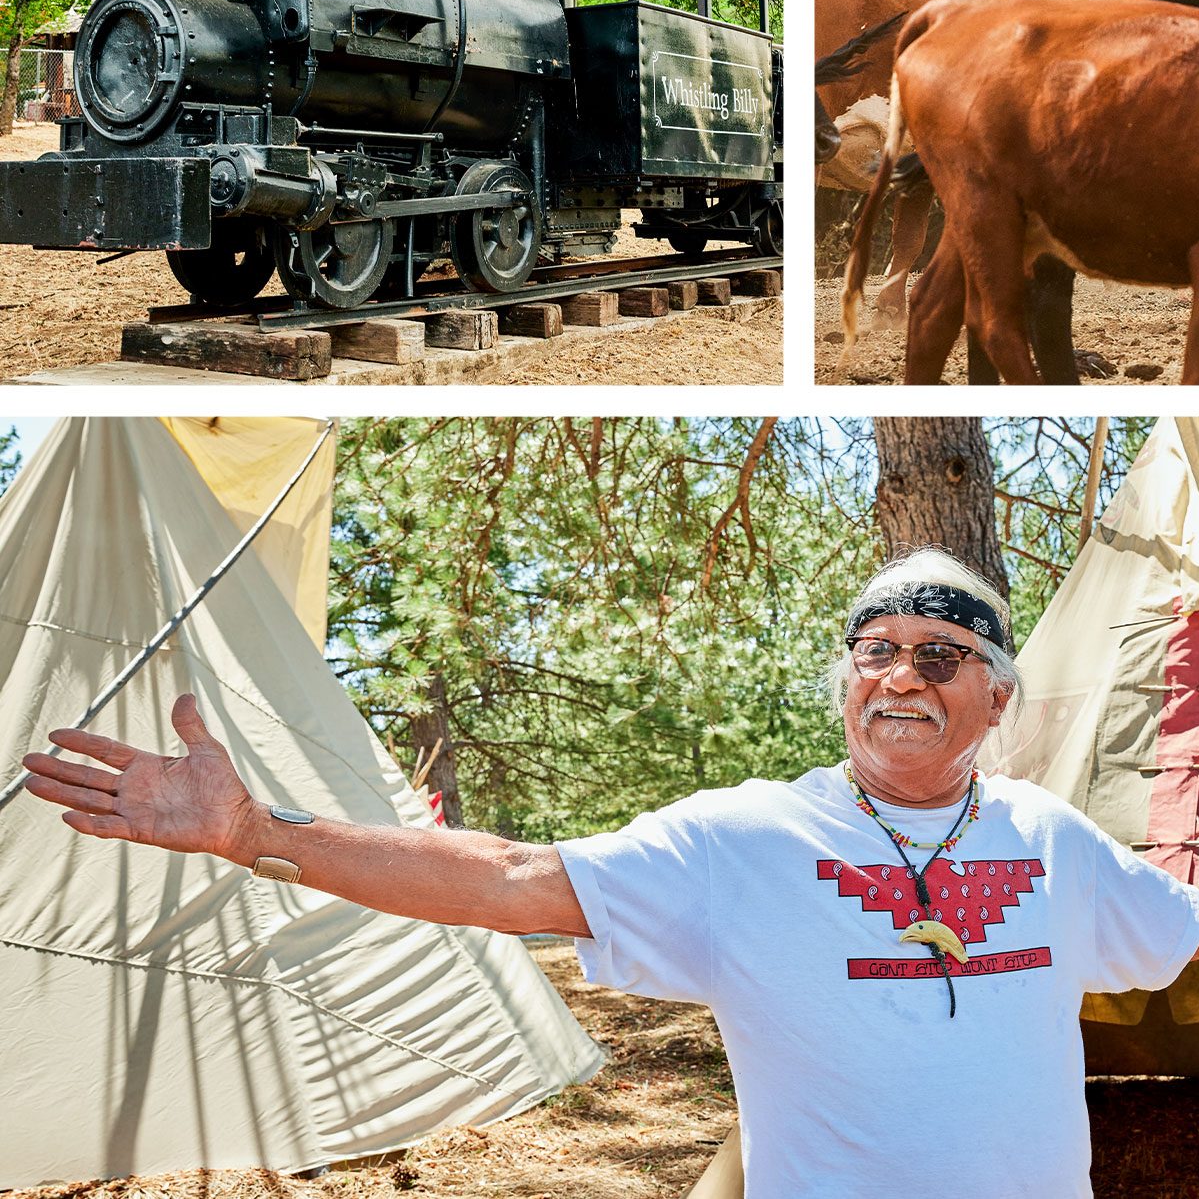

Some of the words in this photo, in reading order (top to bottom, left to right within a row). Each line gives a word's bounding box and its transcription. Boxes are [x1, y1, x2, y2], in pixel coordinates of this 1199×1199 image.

[661, 76, 729, 120] Whistling
[733, 87, 759, 122] Billy
[1004, 952, 1037, 969] STOP
